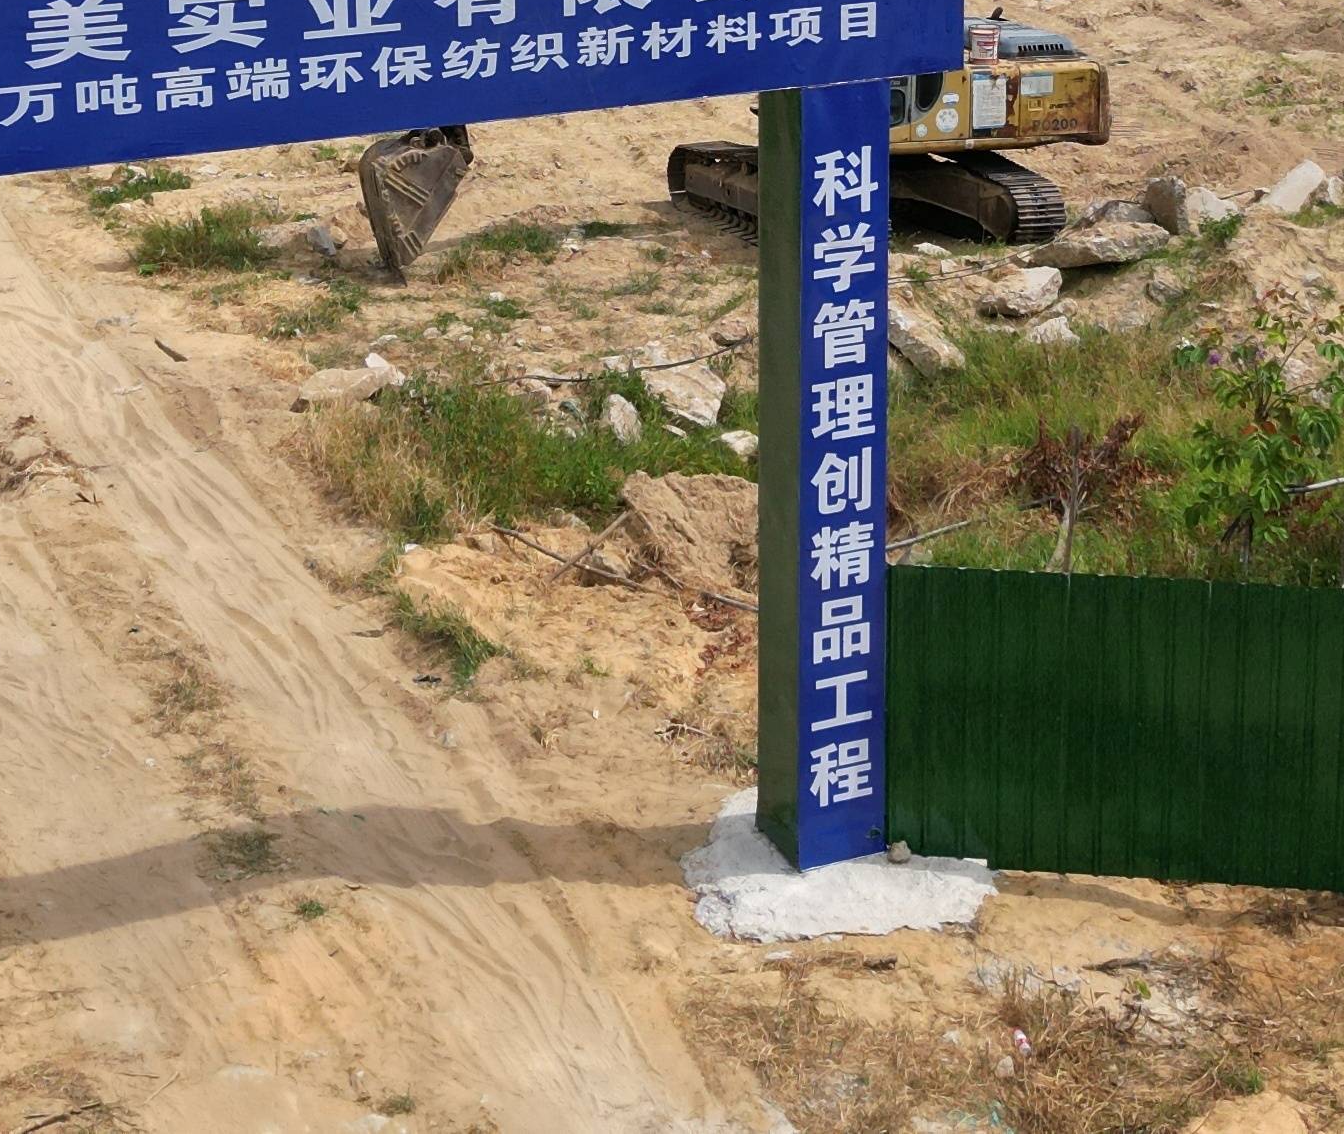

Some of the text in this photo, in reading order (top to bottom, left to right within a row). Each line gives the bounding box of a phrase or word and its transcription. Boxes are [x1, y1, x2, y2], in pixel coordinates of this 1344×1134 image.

[809, 145, 879, 808] 科学管理创精品工程
